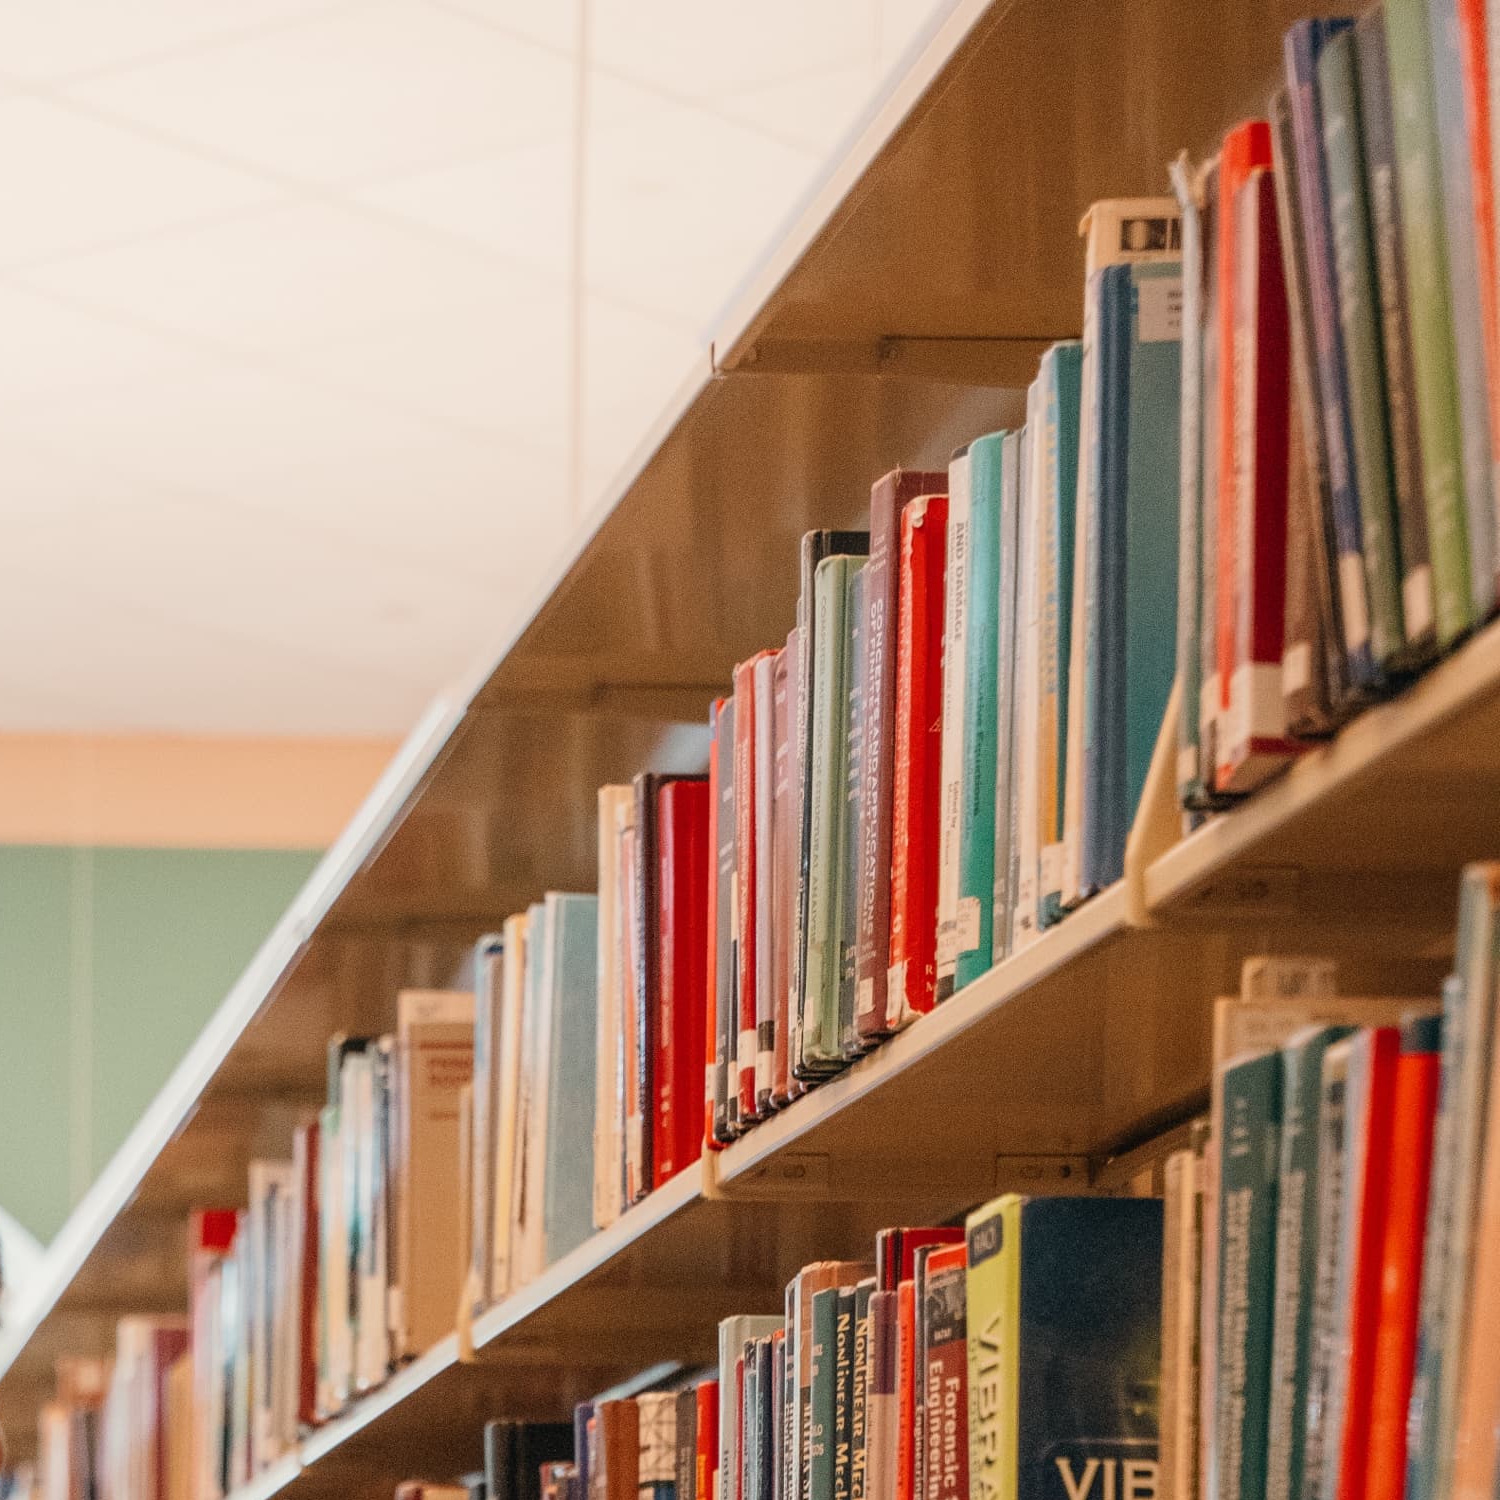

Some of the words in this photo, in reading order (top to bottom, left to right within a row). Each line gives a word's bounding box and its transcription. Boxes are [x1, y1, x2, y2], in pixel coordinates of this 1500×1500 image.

[873, 598, 884, 722] CONCEPTS
[867, 777, 880, 939] APPLICATIONS
[944, 1376, 961, 1490] Forensic
